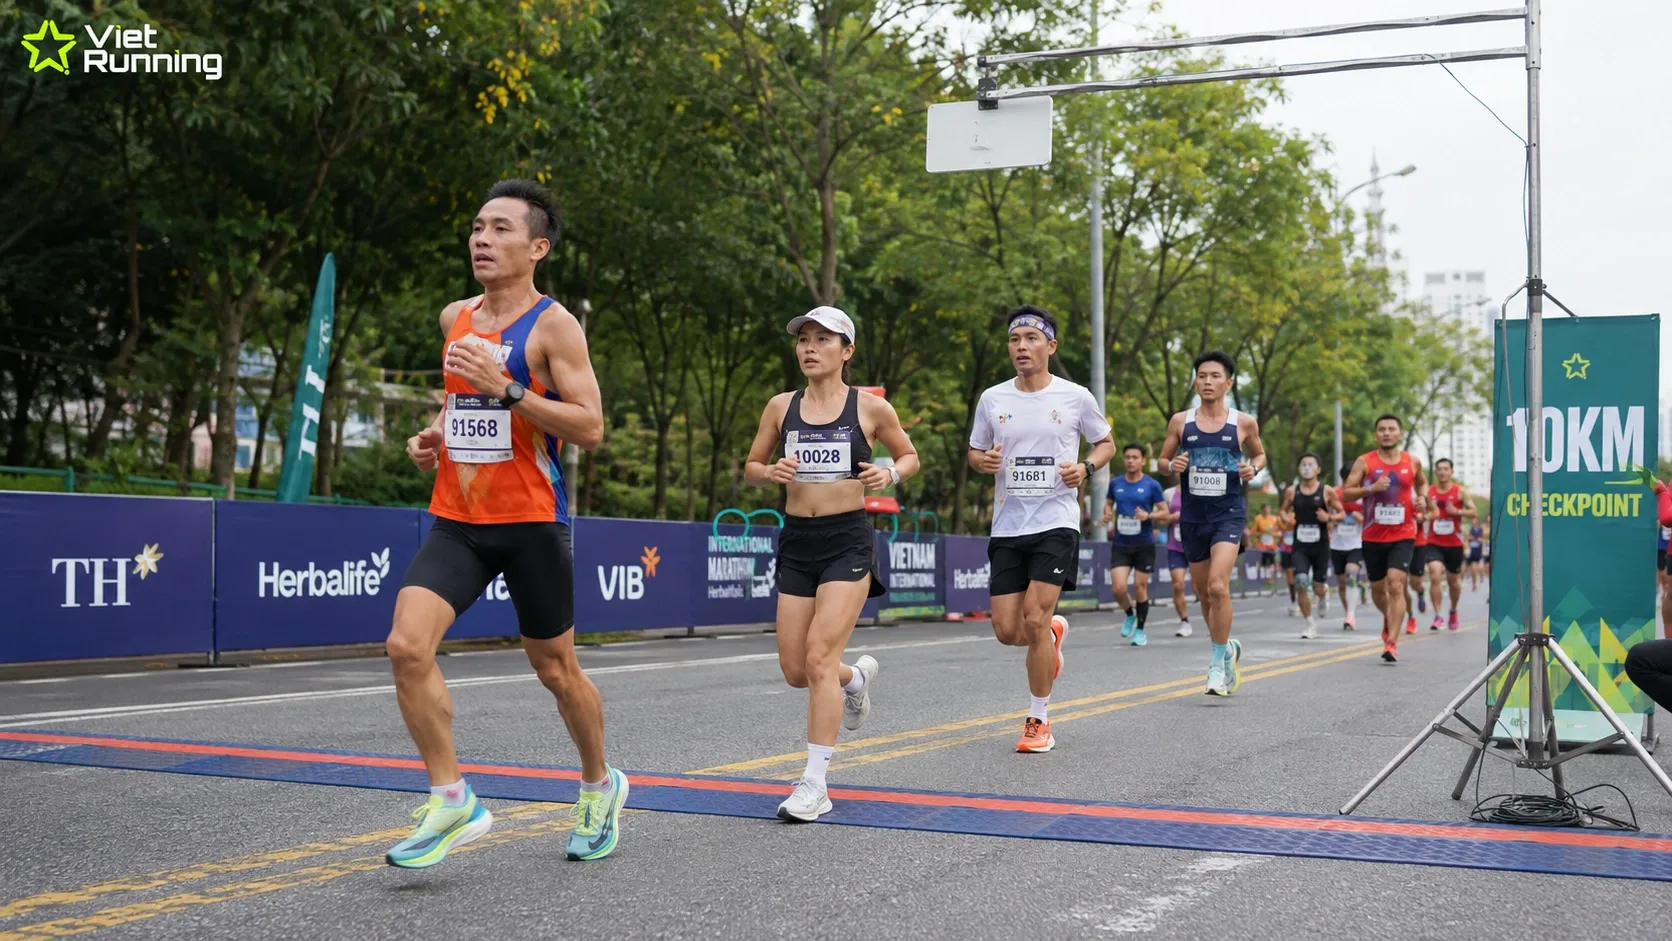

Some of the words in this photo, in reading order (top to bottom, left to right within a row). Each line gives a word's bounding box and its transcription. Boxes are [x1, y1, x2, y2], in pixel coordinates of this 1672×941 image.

[452, 418, 498, 437] 91568
[1506, 406, 1645, 473] 10KM
[793, 449, 841, 464] 10028
[1012, 470, 1046, 482] 91681
[1193, 475, 1221, 486] 91008
[889, 541, 936, 570] VIETNAM
[52, 558, 131, 608] TH
[259, 559, 381, 598] Herbalife
[597, 565, 645, 601] VIB
